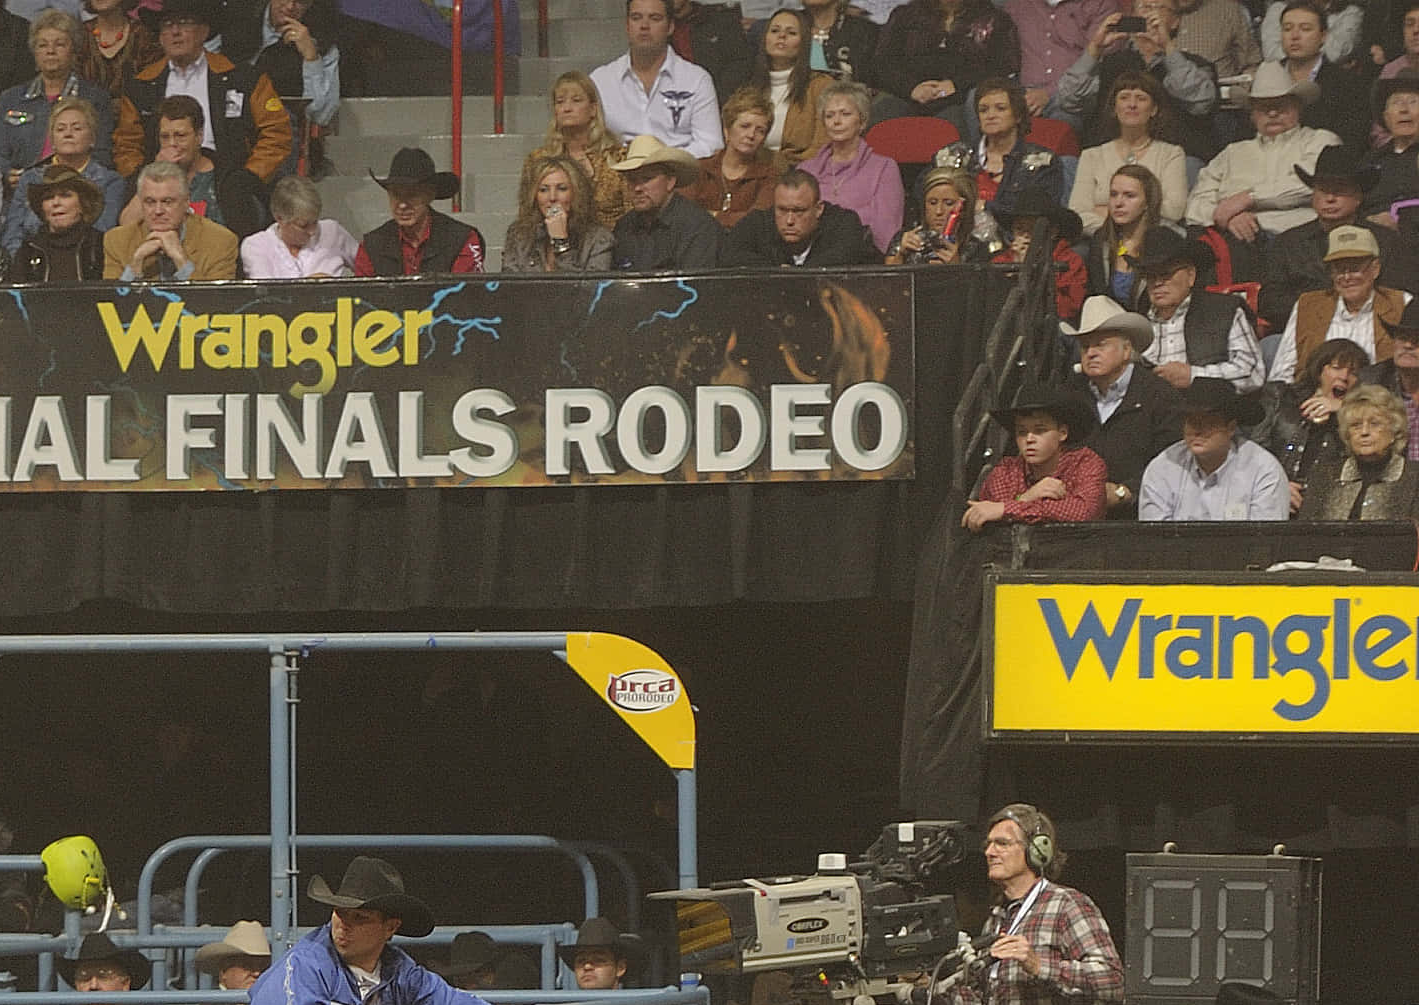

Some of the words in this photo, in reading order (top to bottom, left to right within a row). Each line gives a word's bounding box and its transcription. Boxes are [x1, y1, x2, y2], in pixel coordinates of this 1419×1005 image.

[98, 297, 434, 398] Wrangler
[166, 388, 518, 481] FINALS
[545, 382, 907, 475] RODEO
[610, 677, 675, 703] prca
[617, 691, 674, 704] PRORODEO
[1037, 598, 1419, 721] Wrangle
